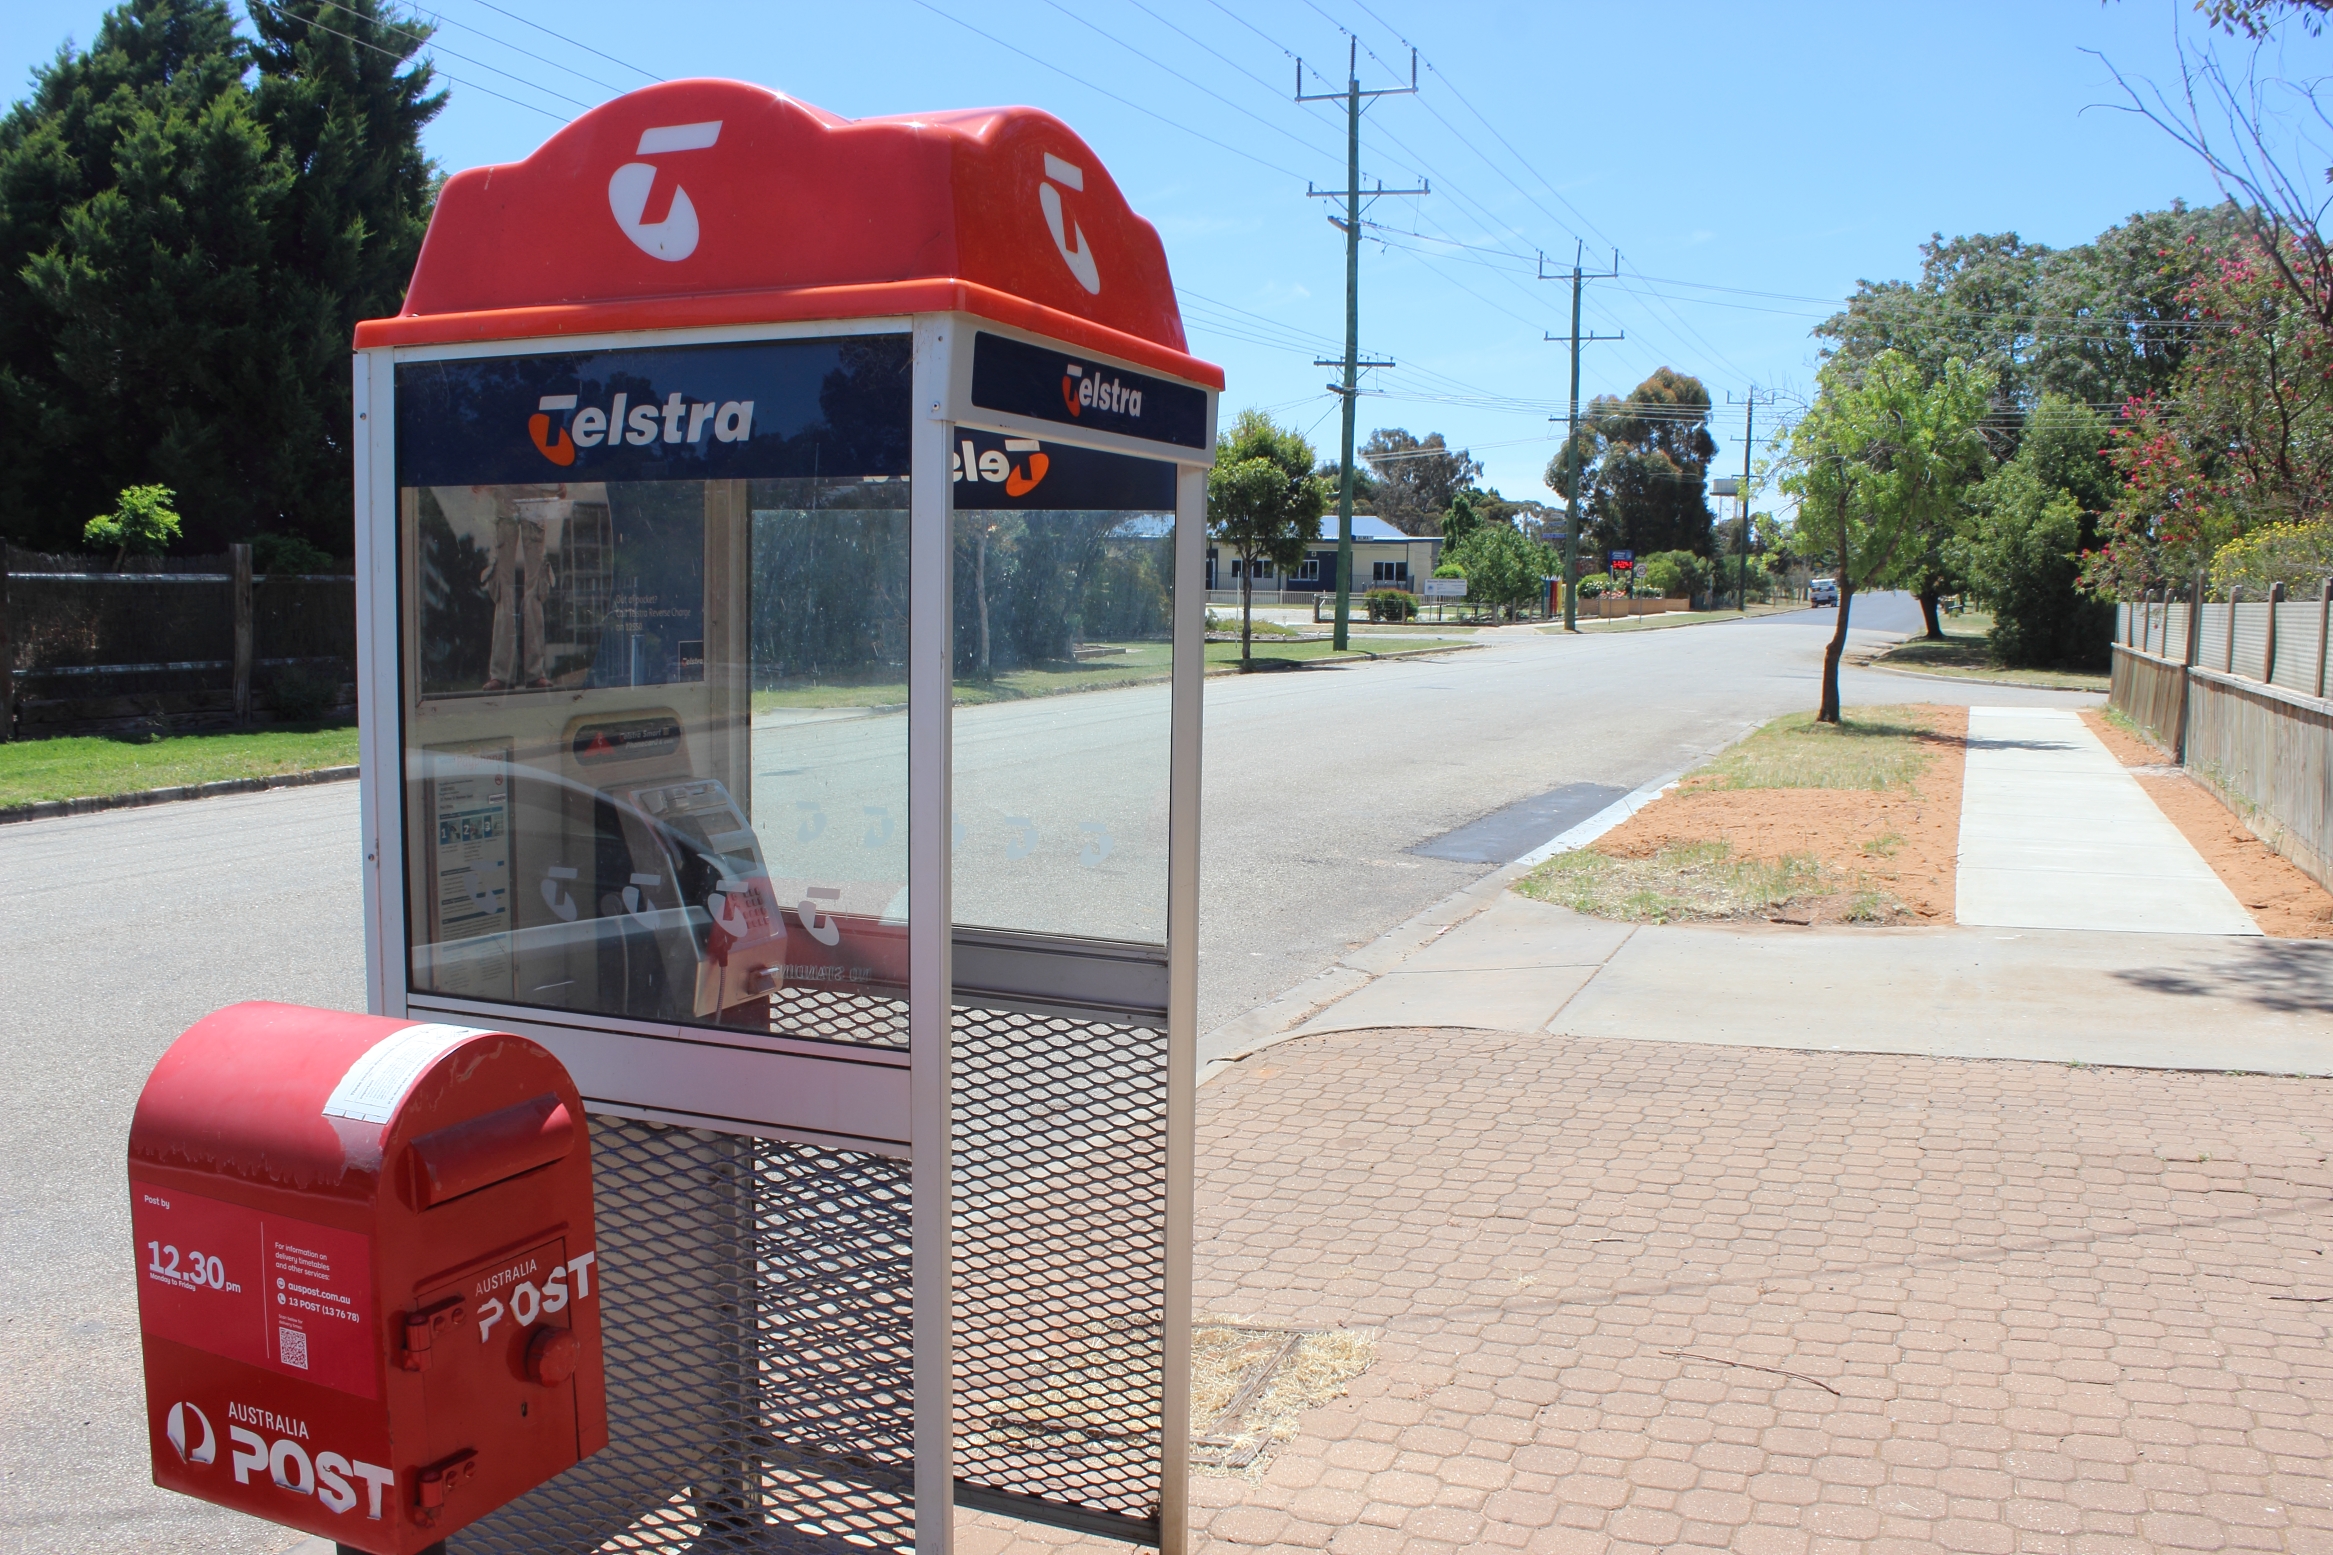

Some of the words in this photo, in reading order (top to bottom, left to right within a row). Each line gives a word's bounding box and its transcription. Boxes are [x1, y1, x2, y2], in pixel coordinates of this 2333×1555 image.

[1062, 363, 1143, 418] Telstra
[528, 392, 754, 466] Telstra
[616, 594, 626, 604] Out
[635, 595, 658, 605] pocket?
[629, 608, 648, 618] Telstra
[648, 608, 670, 617] Reverse
[671, 608, 691, 619] Charge
[682, 658, 703, 667] Telstra
[643, 729, 661, 738] Smart
[144, 1194, 160, 1206] Post
[161, 1198, 170, 1210] by
[275, 1242, 284, 1250] For
[285, 1244, 318, 1259] information
[148, 1240, 225, 1290] 12.30
[226, 1281, 241, 1294] pm
[275, 1252, 298, 1264] delivery
[298, 1257, 330, 1271] timetables
[276, 1262, 287, 1270] and
[288, 1264, 303, 1274] other
[304, 1269, 330, 1280] services:
[150, 1272, 171, 1285] Monday
[172, 1278, 178, 1286] to
[178, 1280, 196, 1292] Friday
[475, 1258, 538, 1297] AUSTRALIA
[288, 1282, 351, 1305] auspost.com.au
[477, 1250, 595, 1344] POST
[288, 1297, 299, 1307] 13
[300, 1300, 321, 1313] POST
[322, 1304, 335, 1316] (13
[336, 1308, 346, 1319] 76
[347, 1311, 360, 1324] 78)
[228, 1401, 310, 1440] AUSTRALIA
[230, 1424, 395, 1520] POST
